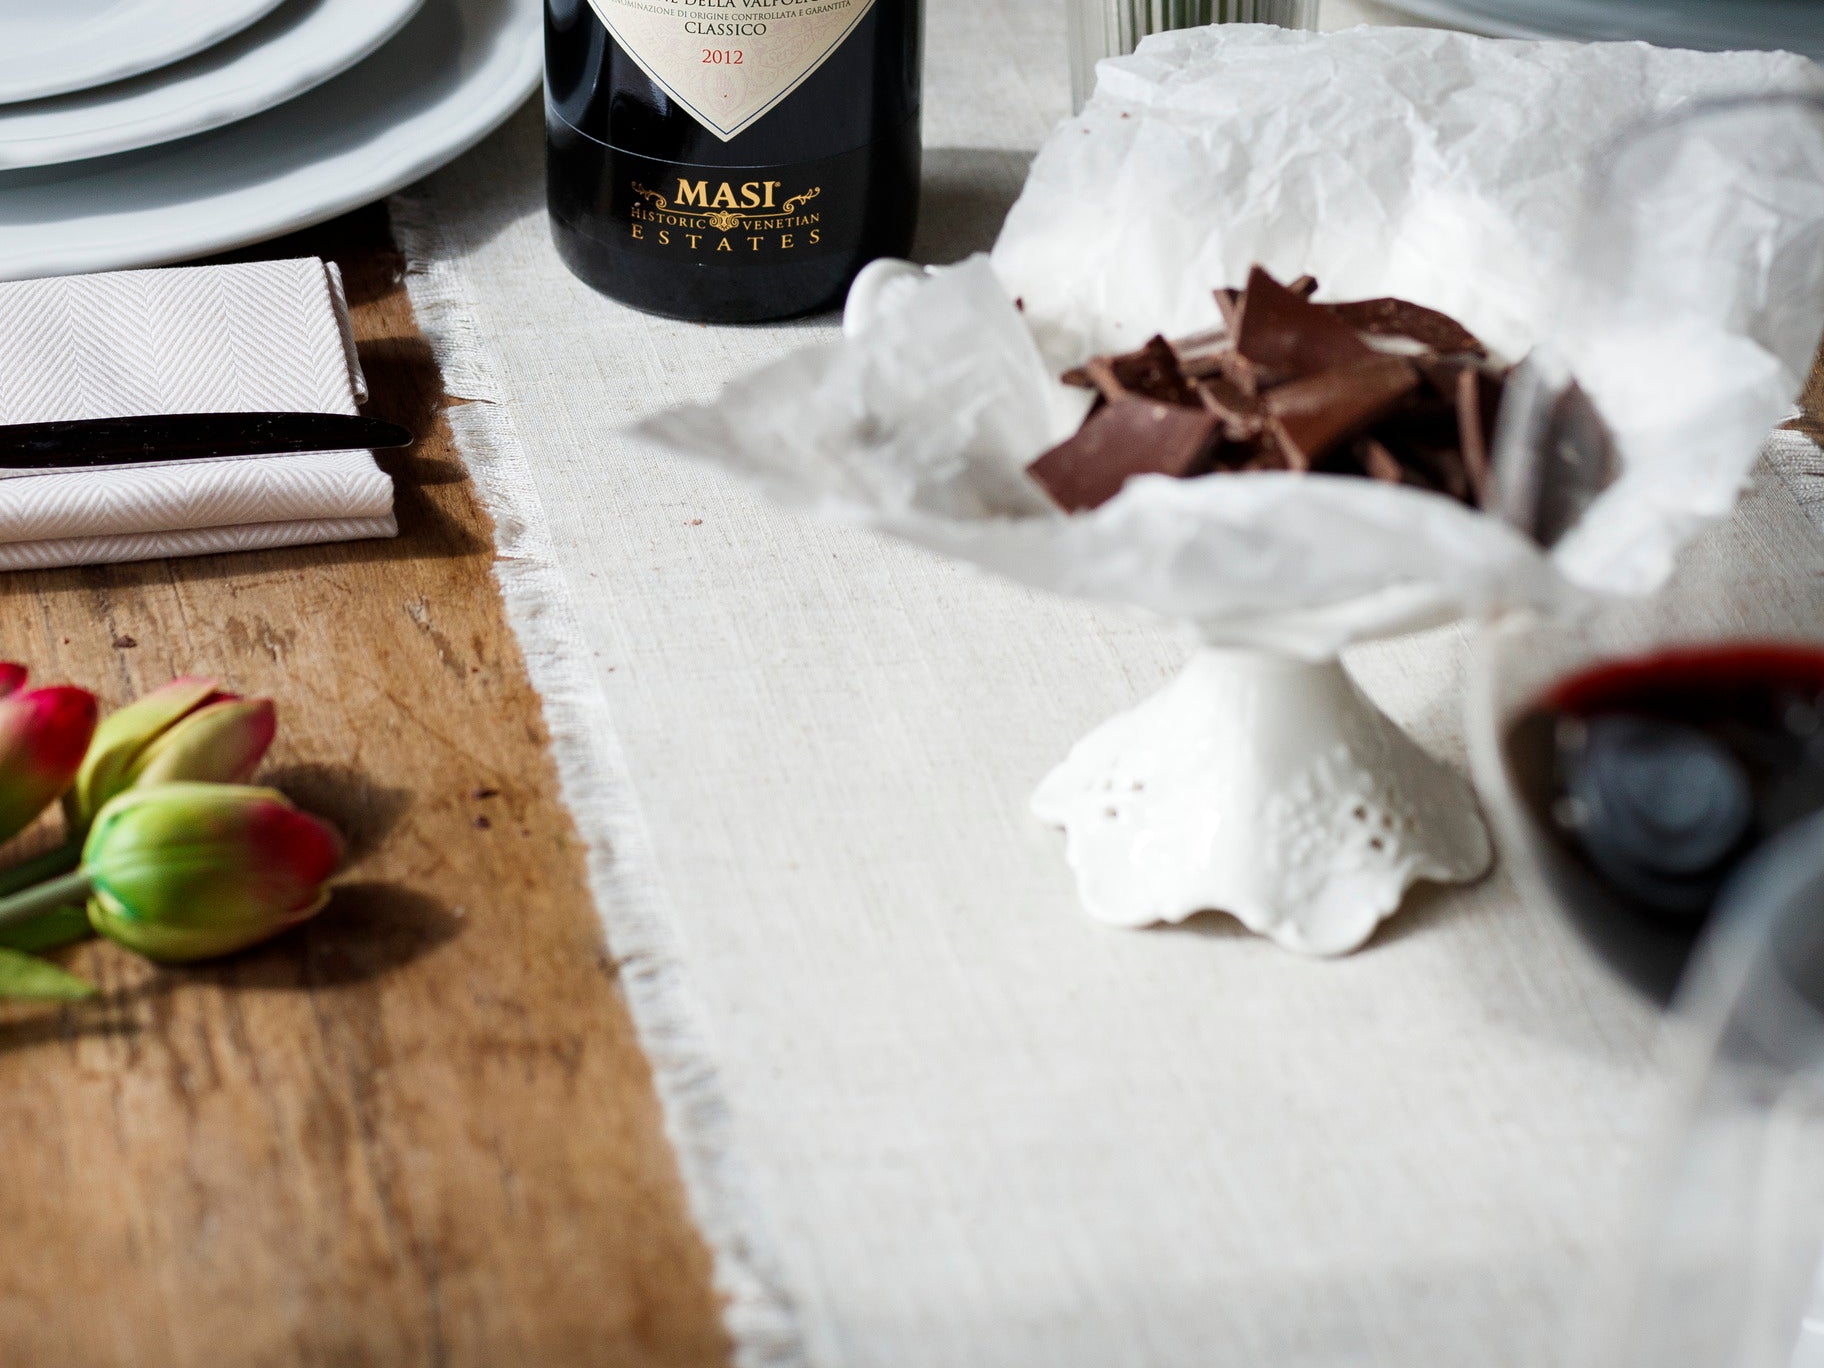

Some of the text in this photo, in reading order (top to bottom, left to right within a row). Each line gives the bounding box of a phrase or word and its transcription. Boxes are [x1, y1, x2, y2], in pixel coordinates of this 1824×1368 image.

[677, 9, 689, 19] DI
[690, 11, 730, 22] ORIGINE
[731, 9, 798, 22] CONTROLLATA
[798, 8, 804, 18] E
[683, 20, 768, 36] CLASSICO
[701, 49, 744, 65] 2012
[631, 206, 821, 231] HISTORIC VENETIAN
[631, 223, 821, 252] ESTATES
